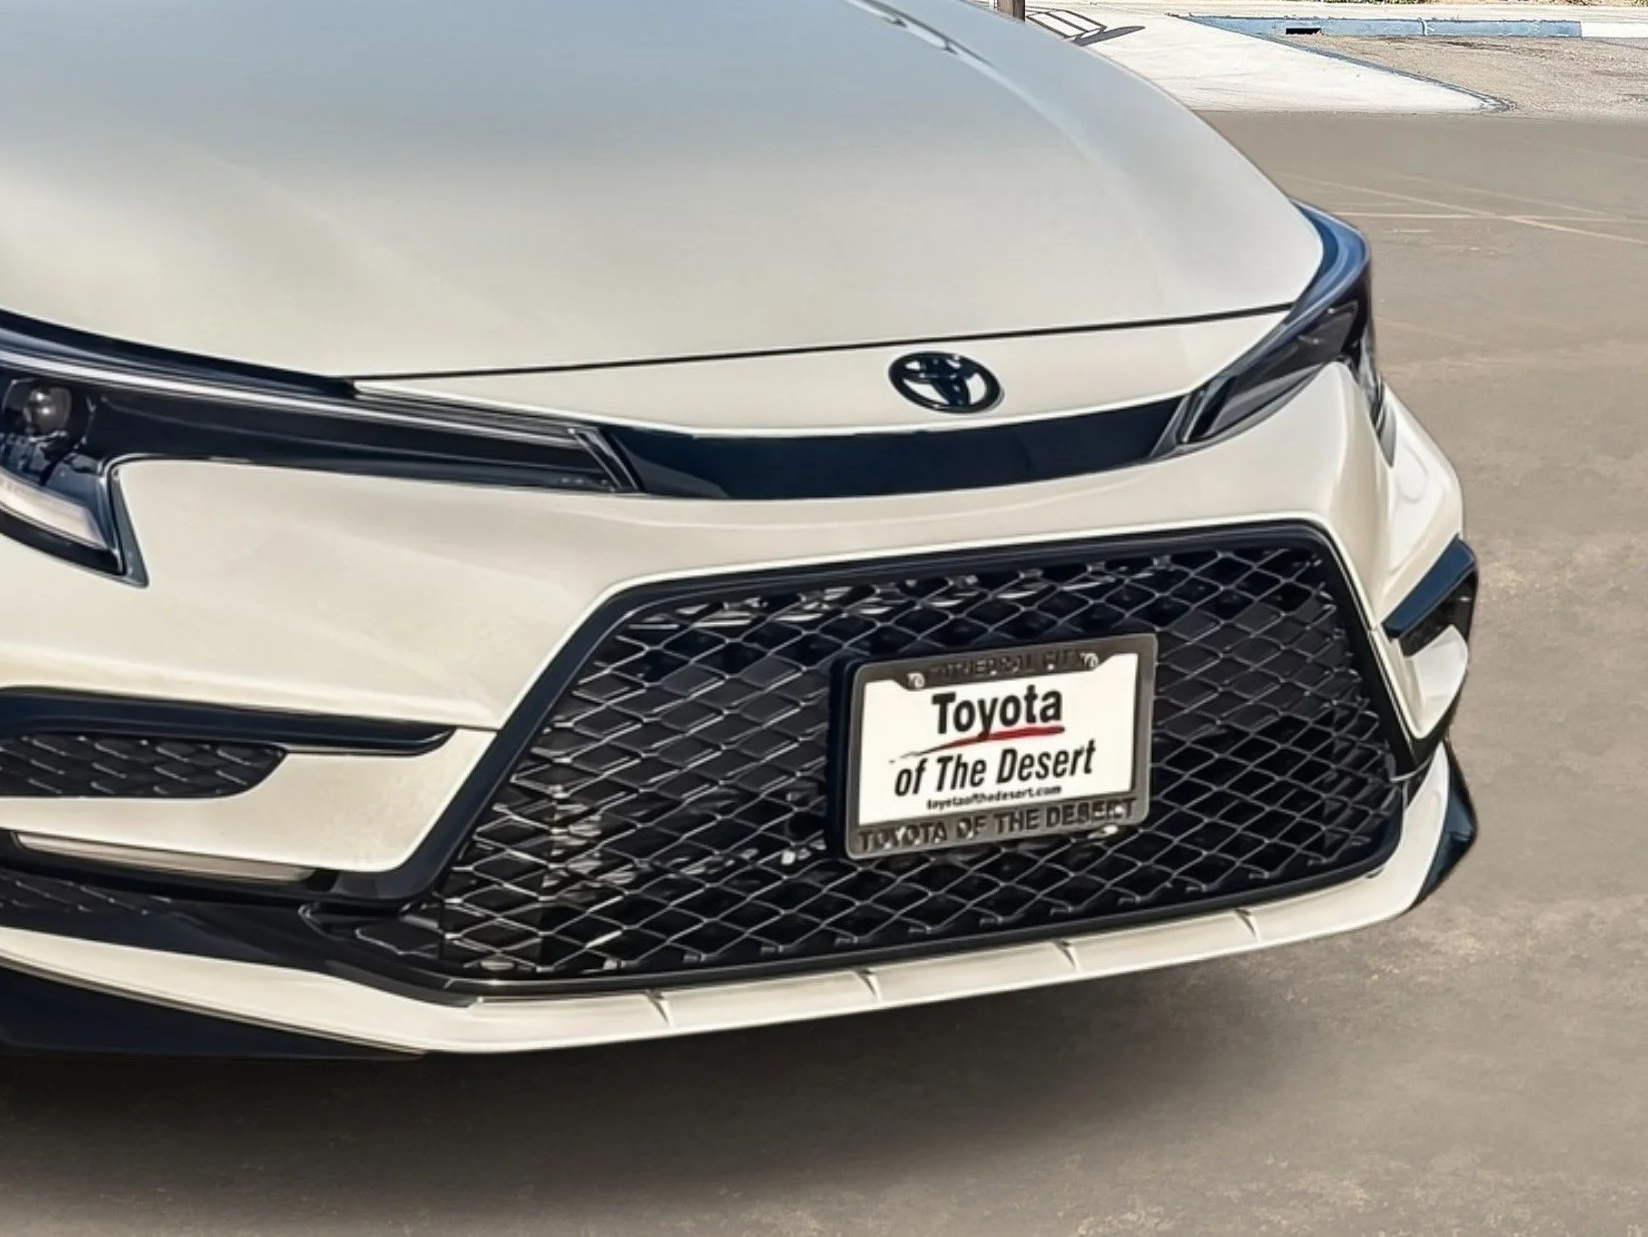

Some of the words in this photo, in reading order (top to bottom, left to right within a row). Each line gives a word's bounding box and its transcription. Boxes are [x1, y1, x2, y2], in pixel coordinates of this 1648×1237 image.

[932, 684, 1063, 739] Toyota
[894, 757, 928, 796] of
[936, 753, 987, 792] The
[996, 739, 1096, 784] Desert
[858, 820, 948, 853] TOYOTA
[993, 807, 1040, 835] THE
[1045, 797, 1139, 828] DESERT
